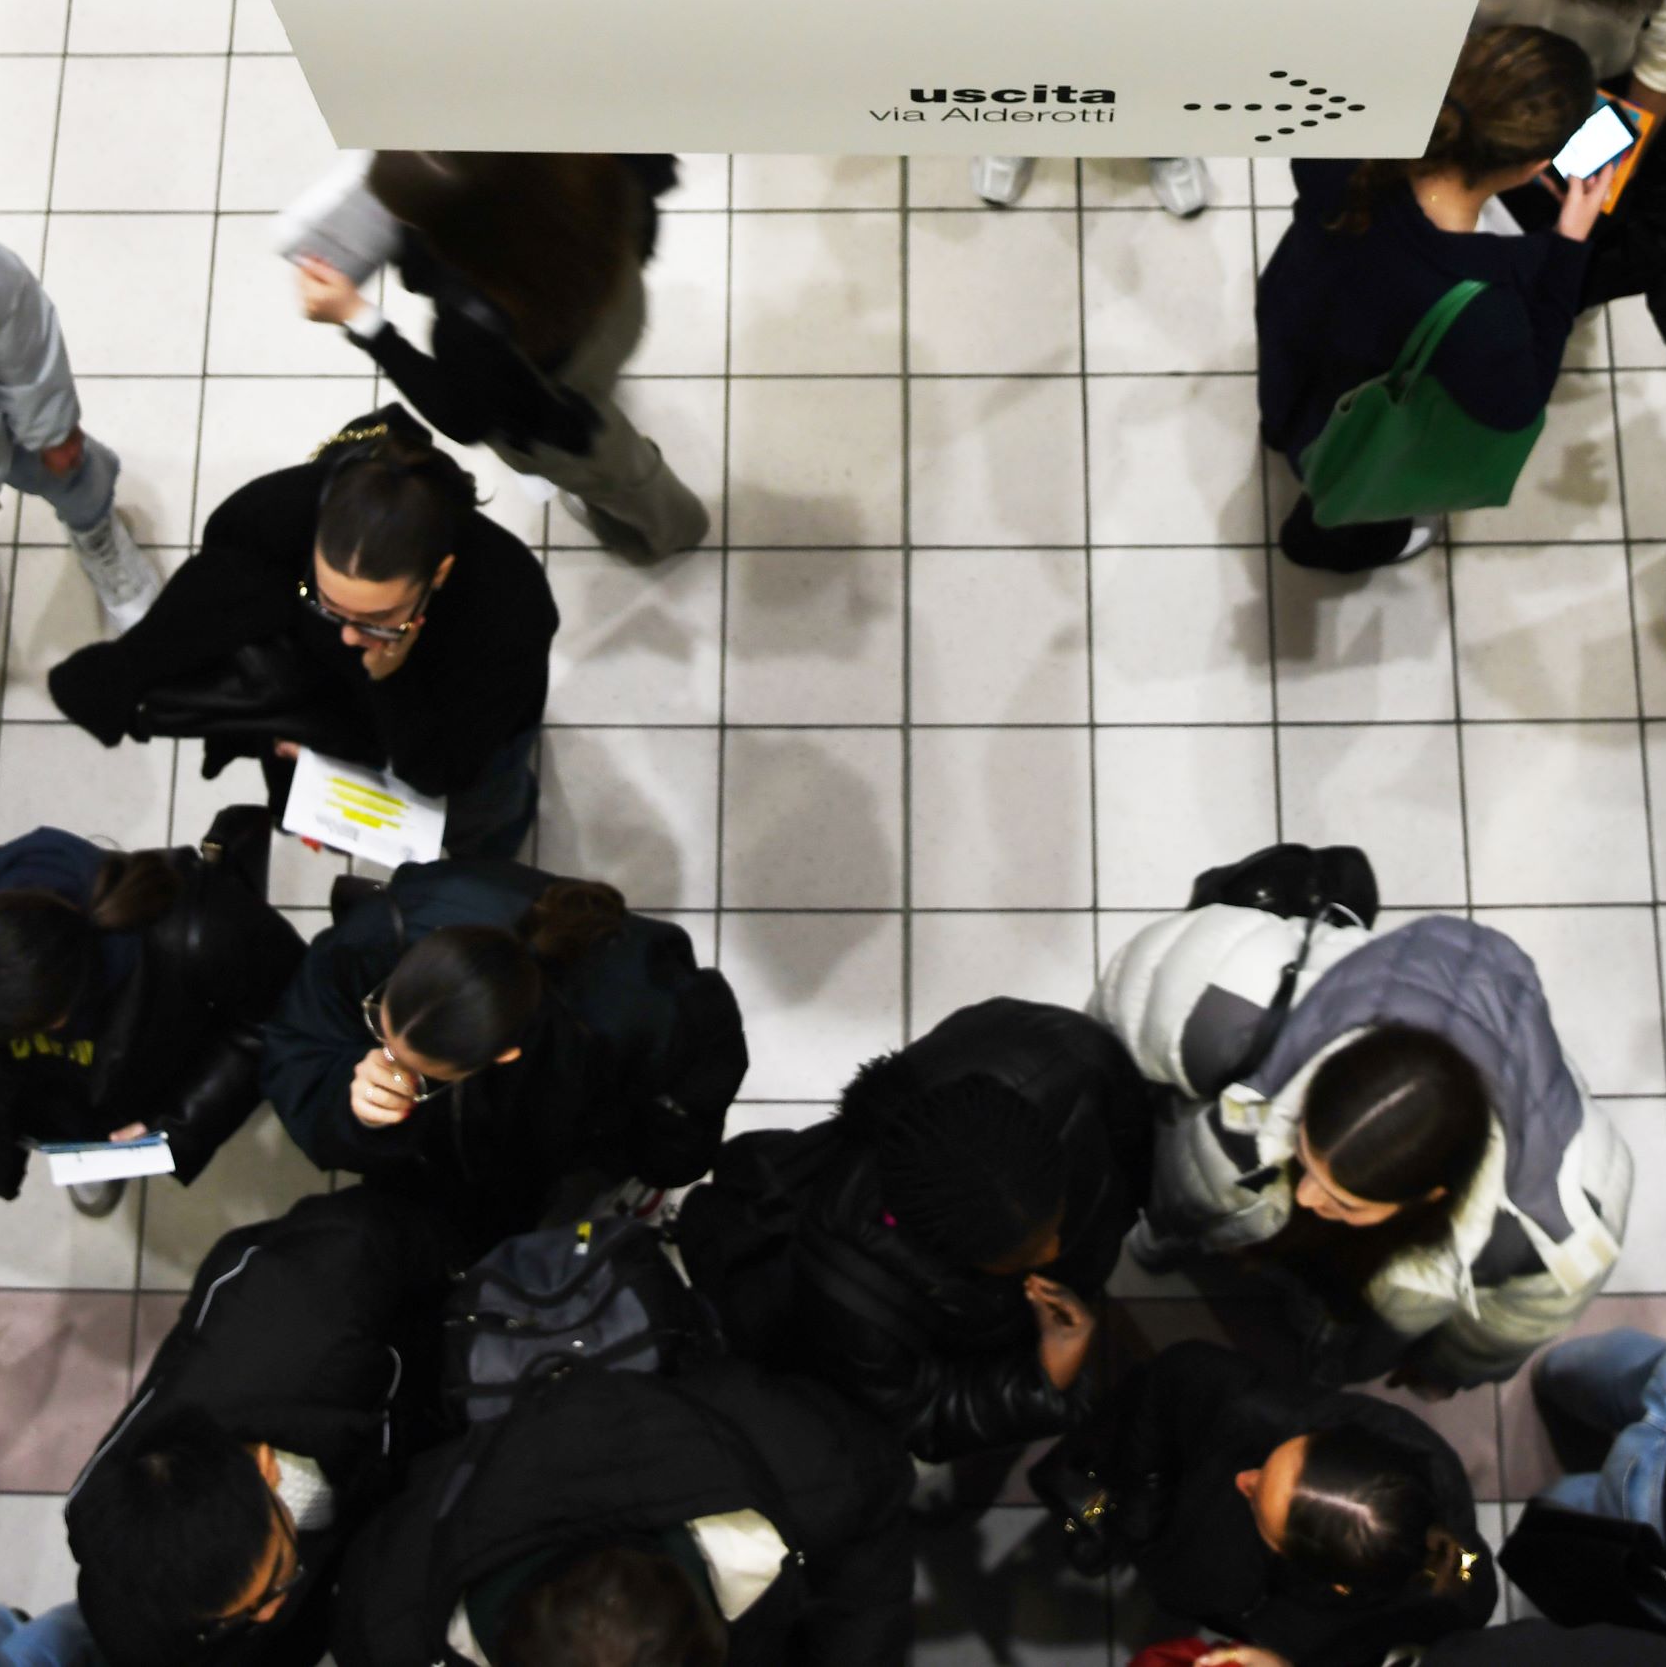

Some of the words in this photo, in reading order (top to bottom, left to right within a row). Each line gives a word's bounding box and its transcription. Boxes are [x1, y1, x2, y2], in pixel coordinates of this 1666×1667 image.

[909, 83, 1117, 104] uscita
[869, 106, 926, 122] via
[940, 106, 1115, 123] Alderotti
